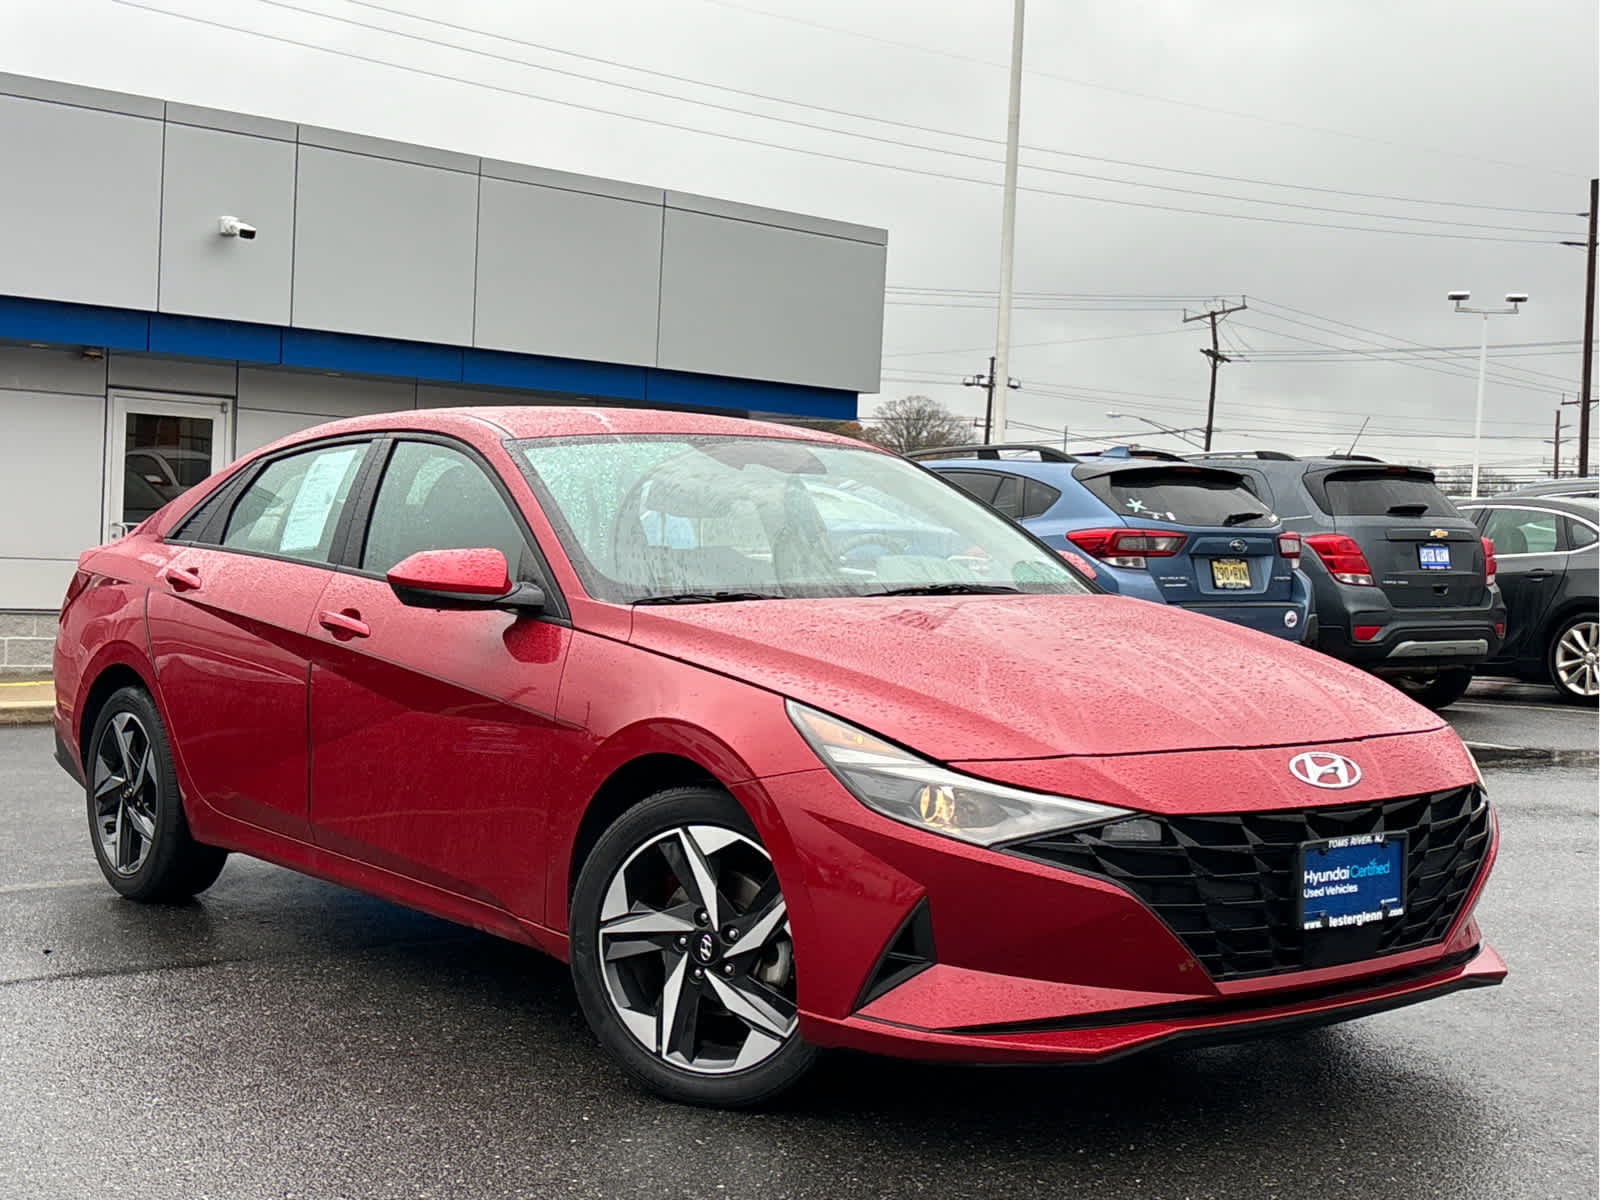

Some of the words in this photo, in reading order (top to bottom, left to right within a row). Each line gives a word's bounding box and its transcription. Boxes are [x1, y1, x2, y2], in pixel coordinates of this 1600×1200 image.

[1304, 866, 1350, 886] Hyundai
[1303, 886, 1325, 899] Used
[1325, 883, 1358, 896] Vehicles
[1328, 911, 1383, 928] lesterglenn
